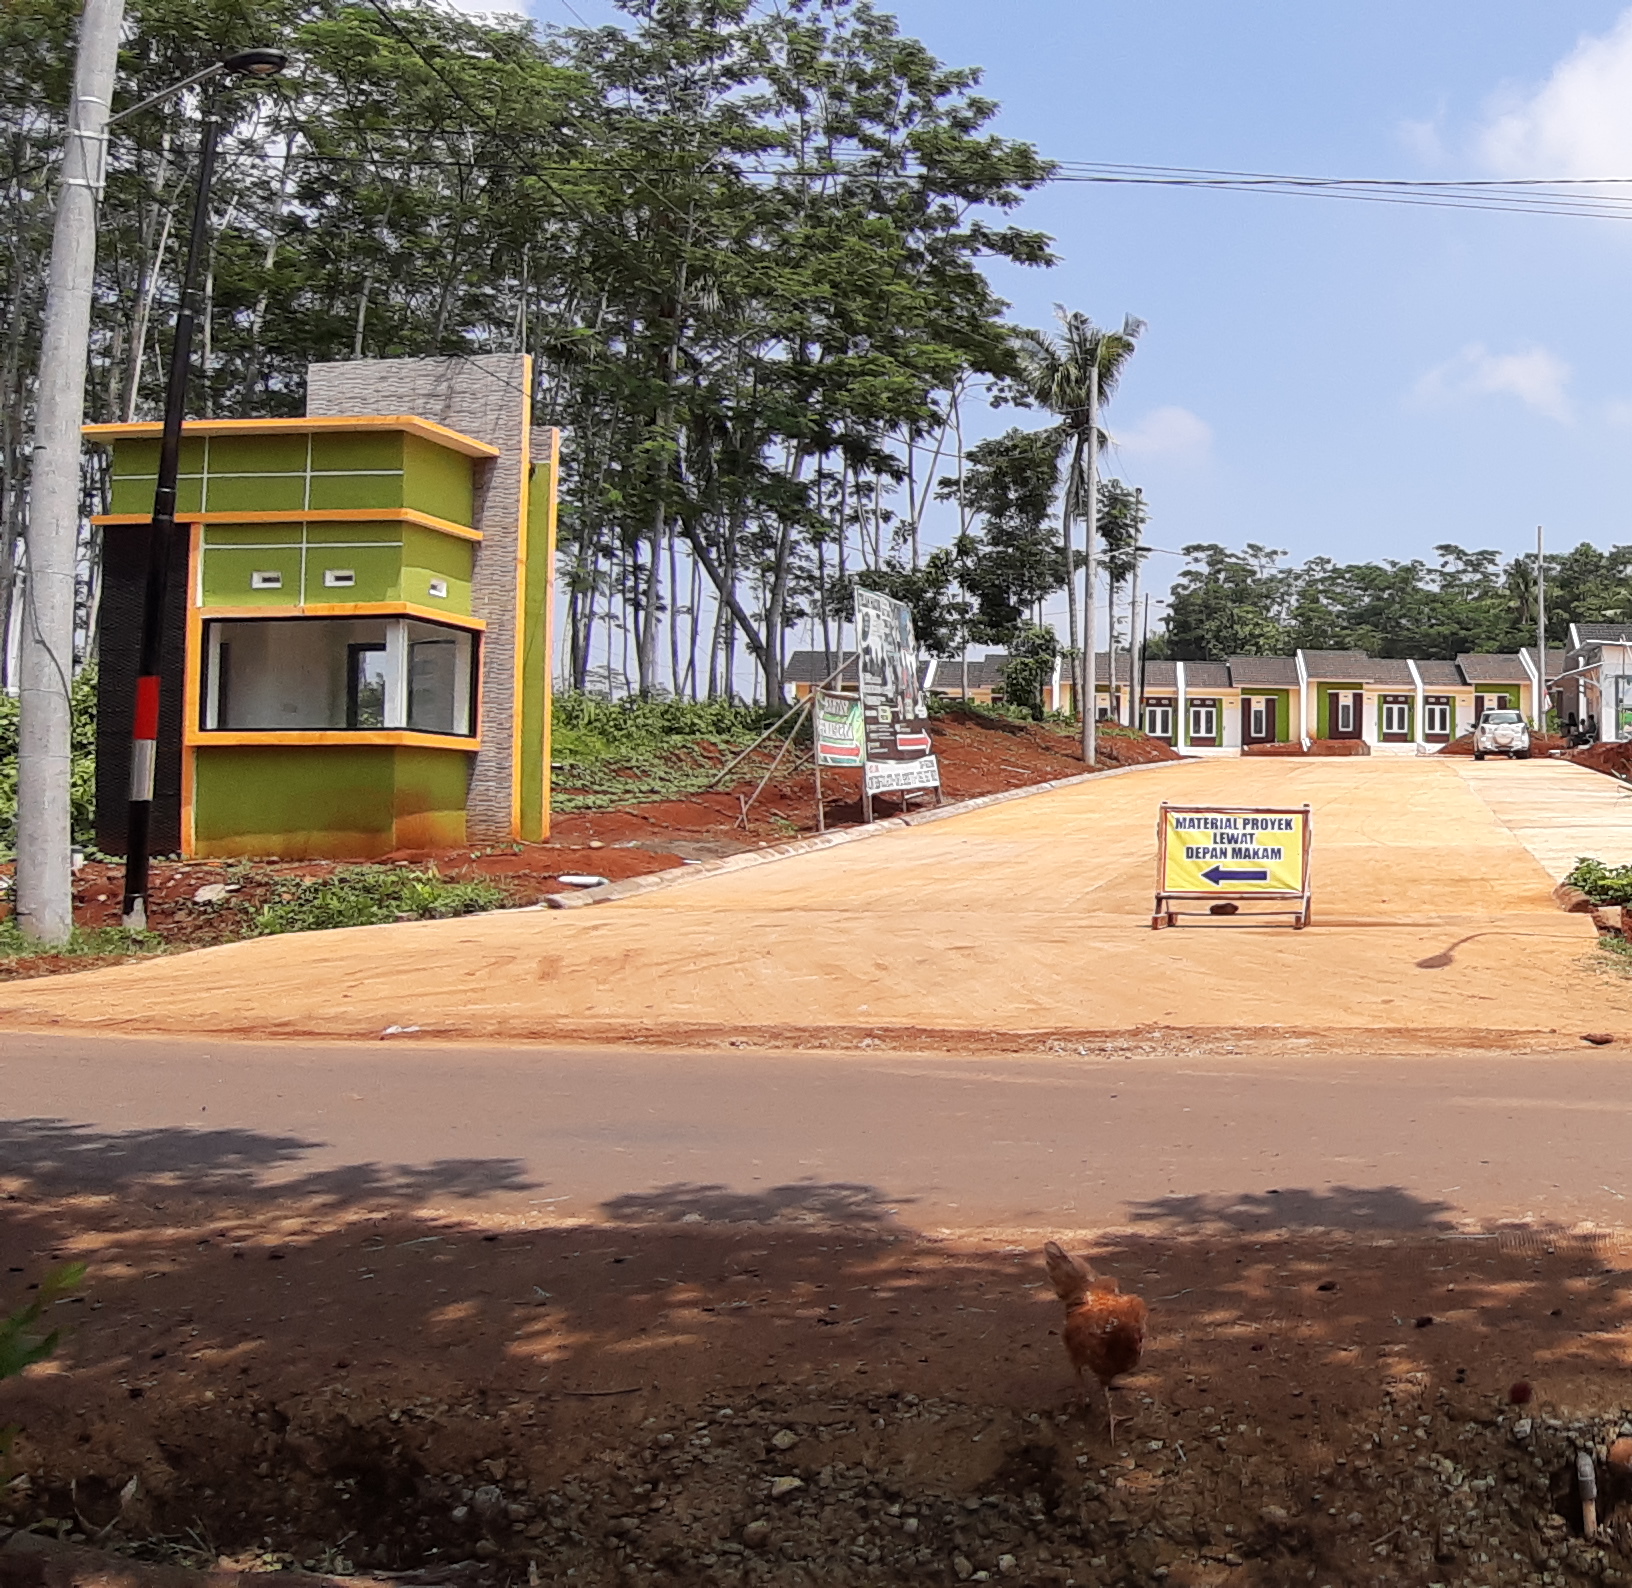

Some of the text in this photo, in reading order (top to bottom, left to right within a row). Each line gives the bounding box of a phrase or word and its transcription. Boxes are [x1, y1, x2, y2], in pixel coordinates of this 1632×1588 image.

[1175, 817, 1293, 831] MATERIAL PROYEK
[1213, 832, 1255, 845] LEWAT
[1186, 847, 1282, 860] DEPAN MAKAM
